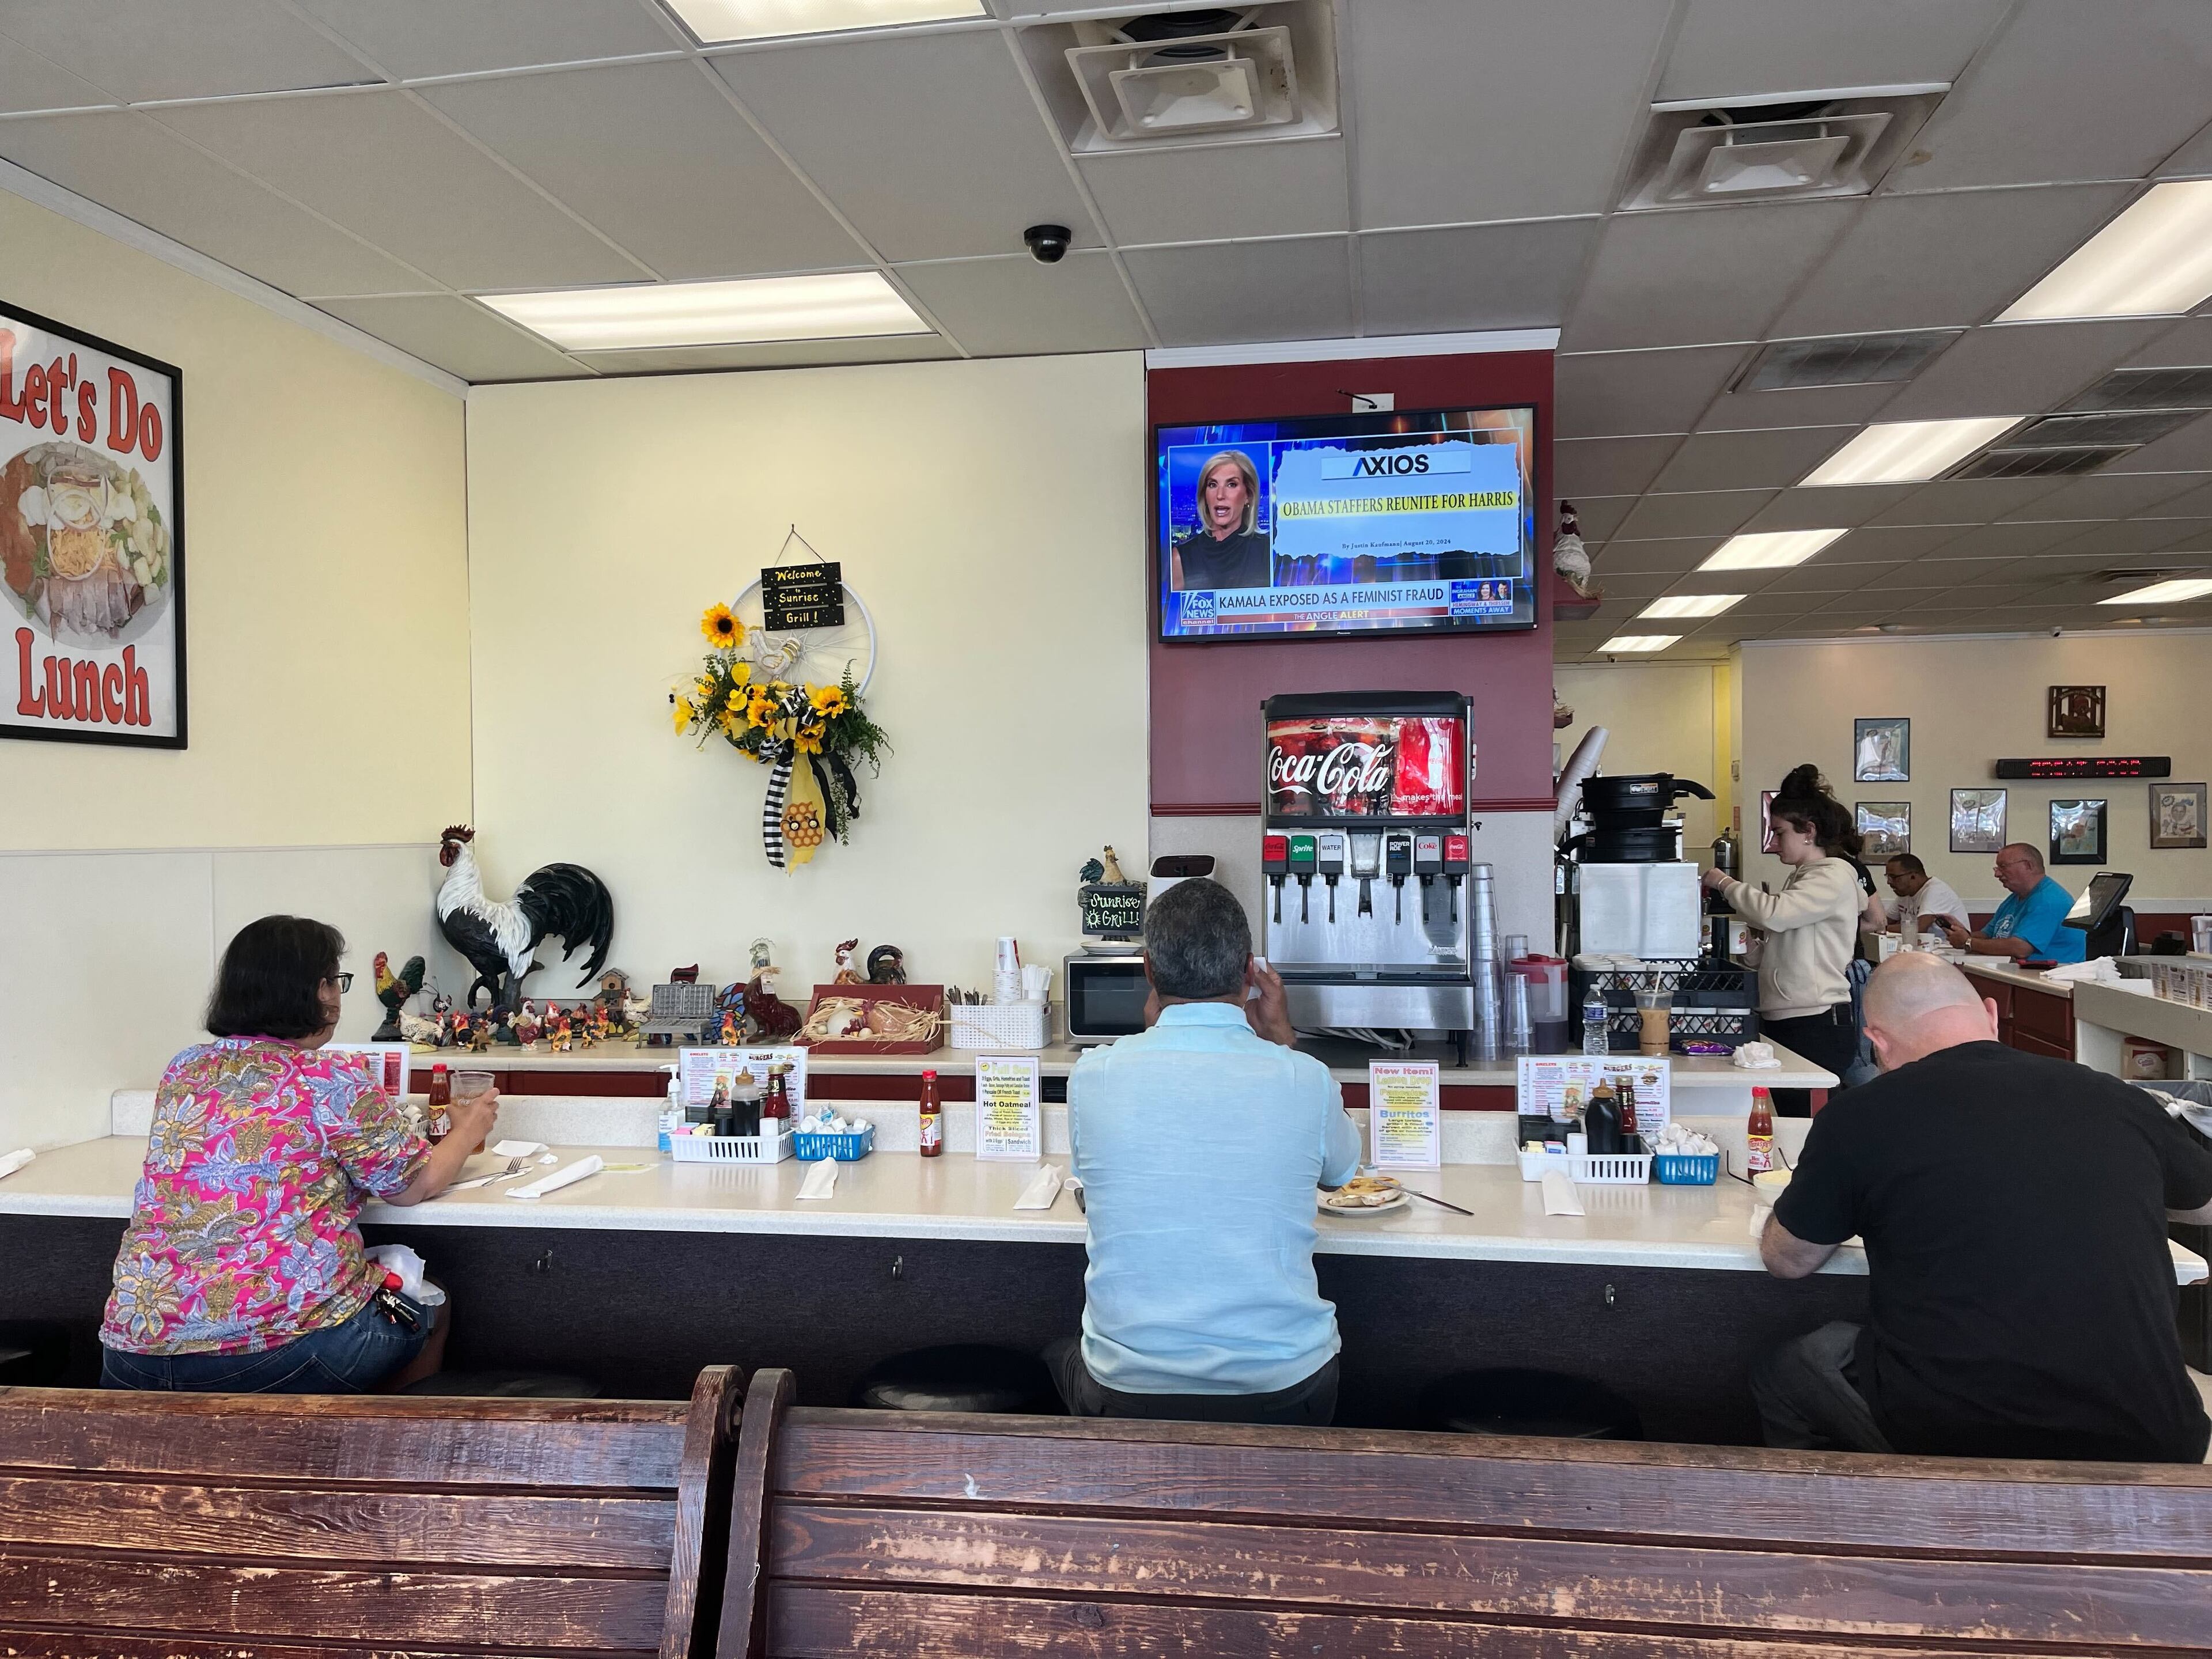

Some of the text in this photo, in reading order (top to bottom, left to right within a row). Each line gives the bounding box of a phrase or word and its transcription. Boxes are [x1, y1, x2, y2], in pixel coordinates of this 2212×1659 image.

[0, 328, 162, 462] Let's Do
[1353, 454, 1429, 476] AXIOS
[1283, 491, 1513, 517] OBAMA STAFFERS REUNITE FOR HARRIS
[775, 570, 823, 581] Welcome
[779, 593, 819, 603] Sunrise
[1192, 599, 1213, 608] FOX
[1219, 588, 1443, 608] KAMALA EXPOSED AS A FEMINIST FRAUD
[1187, 609, 1214, 618] NEWS
[1306, 612, 1338, 620] ANGLE
[1340, 610, 1369, 619] ALERT
[15, 627, 151, 727] Lunch
[1267, 742, 1394, 795] Coca-Cola
[1403, 793, 1430, 801] makes
[1448, 793, 1463, 801] meal
[1292, 845, 1313, 854] Sprite
[1376, 1075, 1432, 1086] Lemon Drop
[1380, 1110, 1430, 1118] Burritos
